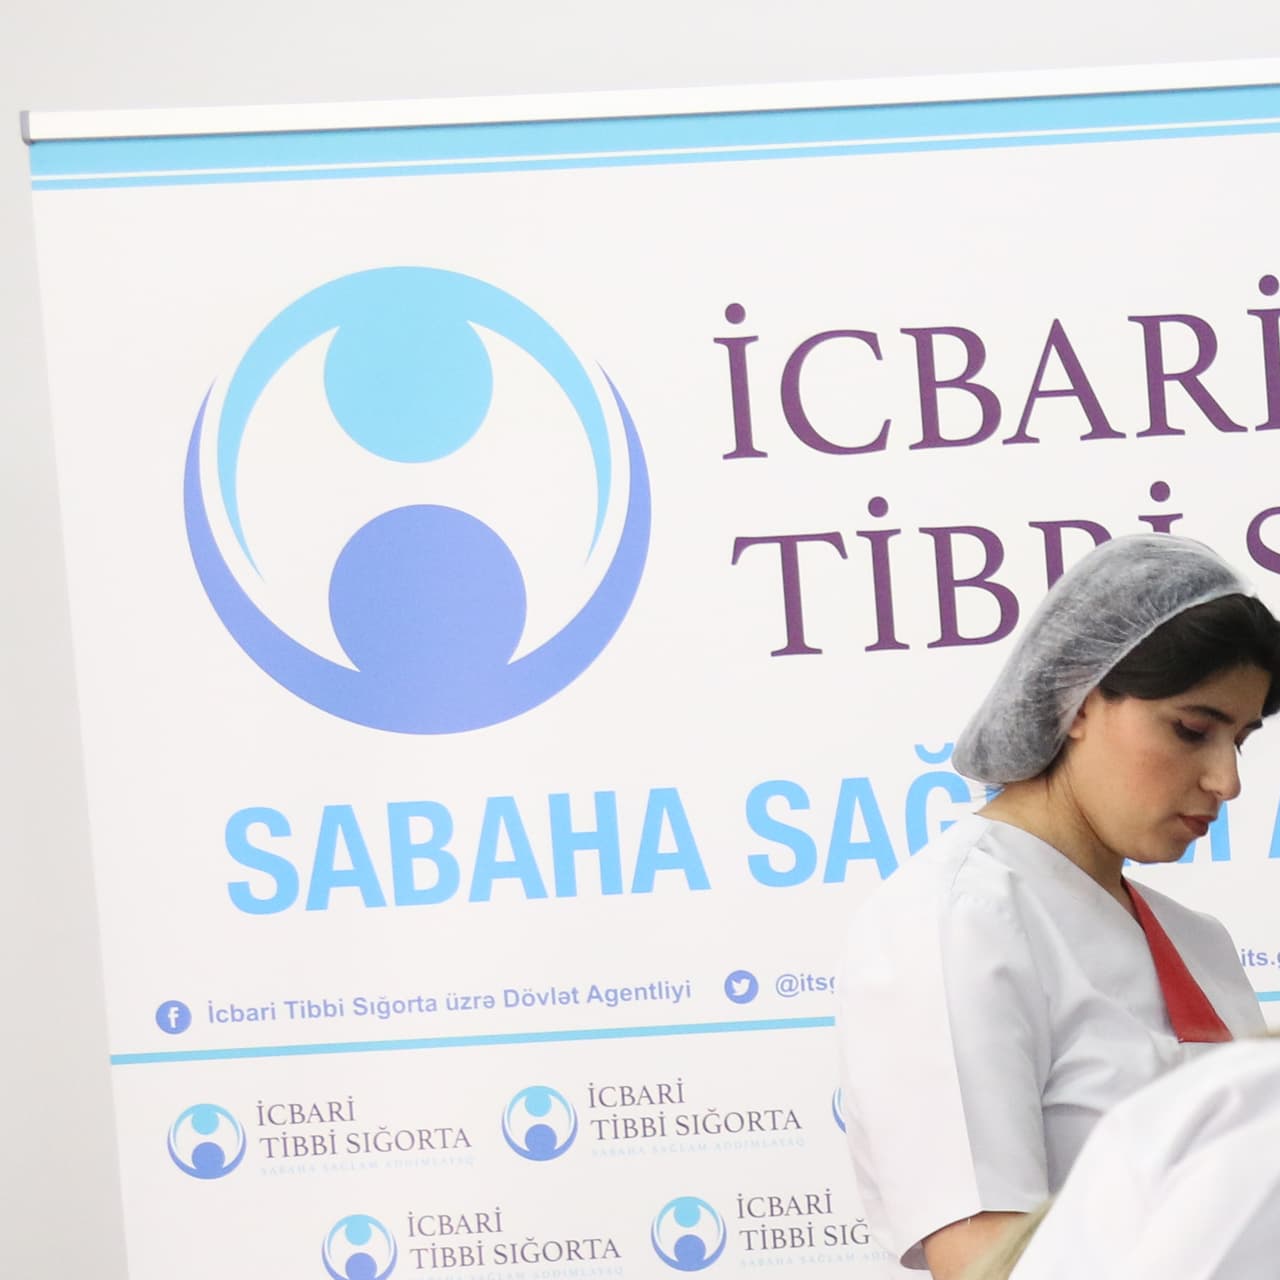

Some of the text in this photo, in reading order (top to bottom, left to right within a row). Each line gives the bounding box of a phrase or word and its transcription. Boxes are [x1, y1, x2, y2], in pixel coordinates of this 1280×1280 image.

[731, 481, 1183, 657] TİB
[225, 787, 711, 915] SABAHA
[207, 979, 691, 1025] İcbari Tibbi Sığorta üzrə Dövlət Agentliyi
[587, 1077, 687, 1108] İCBARİ
[256, 1096, 356, 1126] İCBARİ
[590, 1108, 803, 1141] TİBBİ SIĞORTA
[259, 1125, 473, 1159] TİBBİ SIĞORTA
[737, 1188, 833, 1219] İCBARİ
[408, 1207, 503, 1238] İCBARİ
[739, 1221, 816, 1252] TİBBİ
[409, 1237, 622, 1270] TİBBİ SIĞORTA
